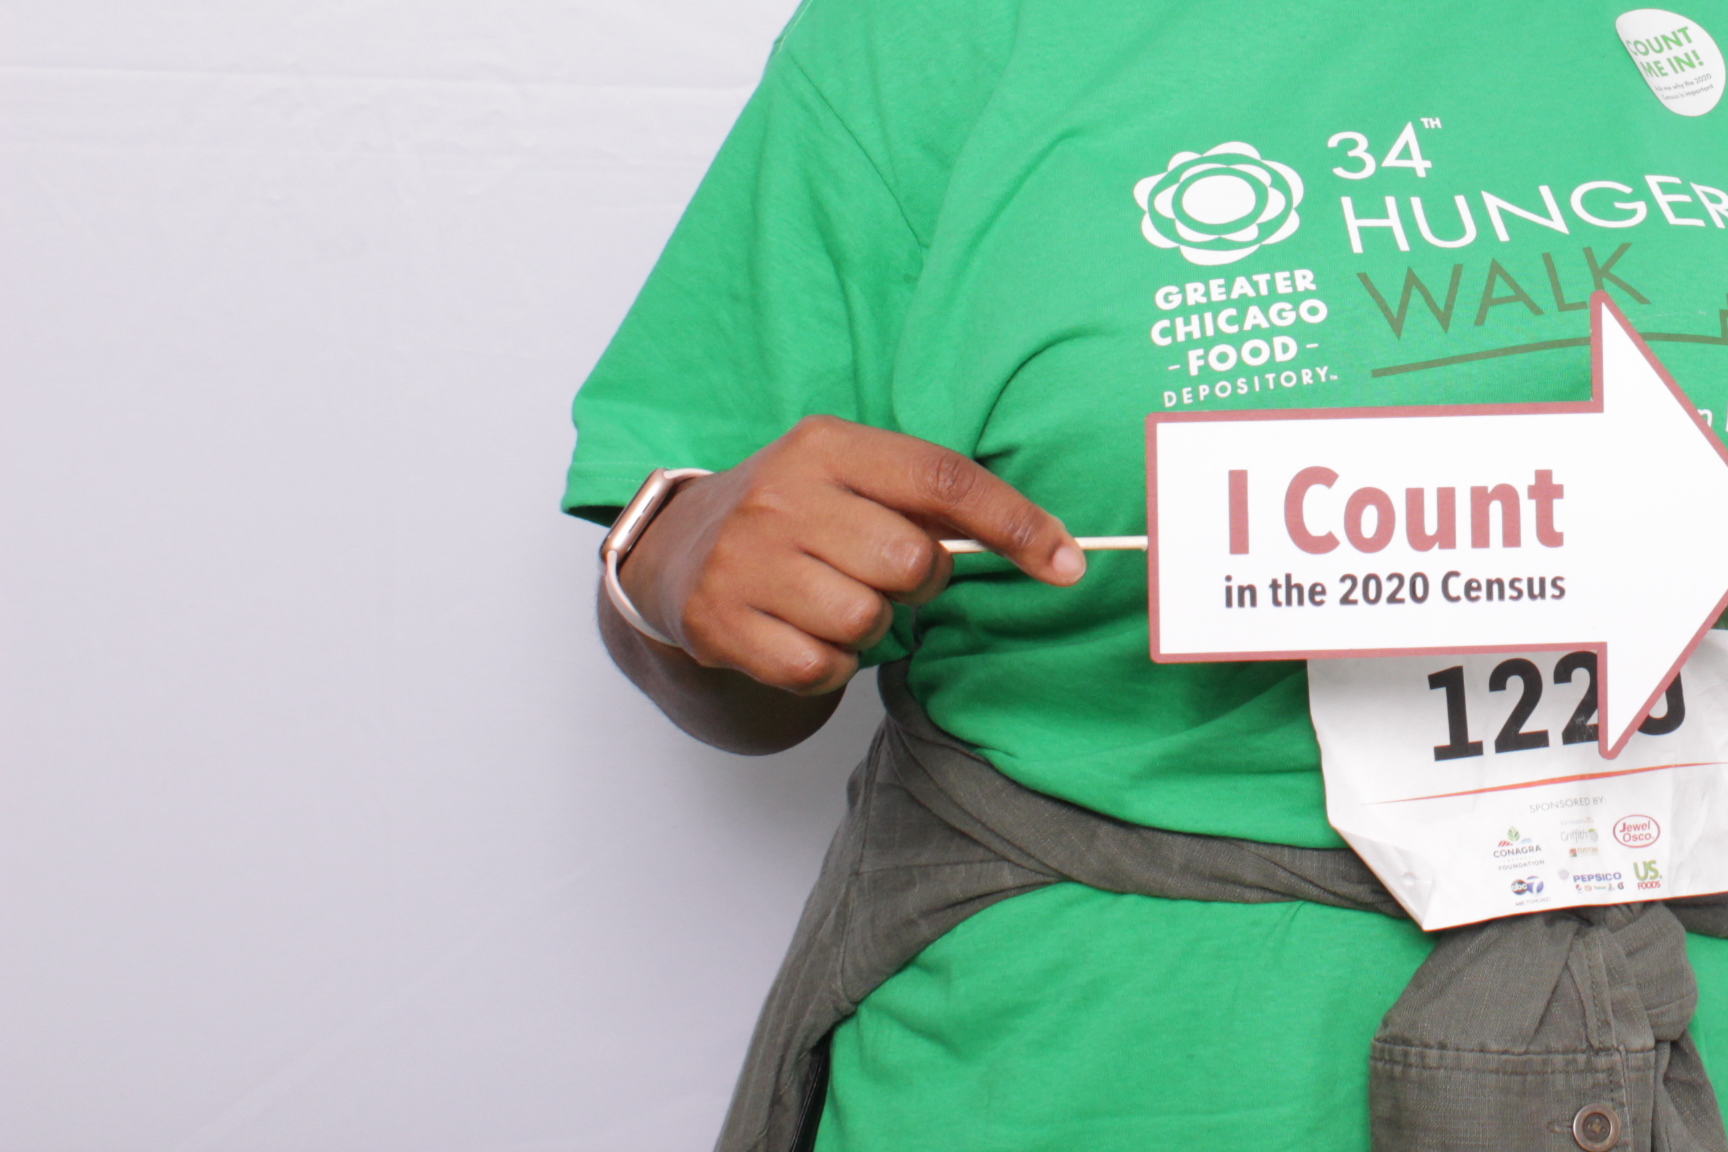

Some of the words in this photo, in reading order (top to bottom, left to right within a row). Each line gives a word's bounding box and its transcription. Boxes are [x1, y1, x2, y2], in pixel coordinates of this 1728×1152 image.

[1625, 26, 1693, 56] COUNT
[1639, 60, 1669, 78] ME
[1666, 49, 1705, 74] IN!
[1694, 73, 1712, 84] 2020
[1684, 83, 1714, 96] important
[1154, 269, 1317, 311] GREATER
[1356, 242, 1652, 341] WALK
[1151, 298, 1328, 346] CHICAGO
[1228, 469, 1249, 555] I
[1284, 465, 1564, 555] Count
[1225, 575, 1257, 608] in
[1269, 573, 1327, 607] the
[1339, 572, 1430, 606] 2020
[1441, 570, 1566, 603] Census
[1529, 797, 1591, 814] SPONSORED
[1619, 820, 1651, 833] Jewel
[1560, 828, 1588, 843] Griffith
[1493, 844, 1542, 858] CONAGRA
[1498, 860, 1545, 871] FOUNDATION
[1573, 871, 1622, 883] PEPSICO
[1637, 880, 1661, 889] FOODS
